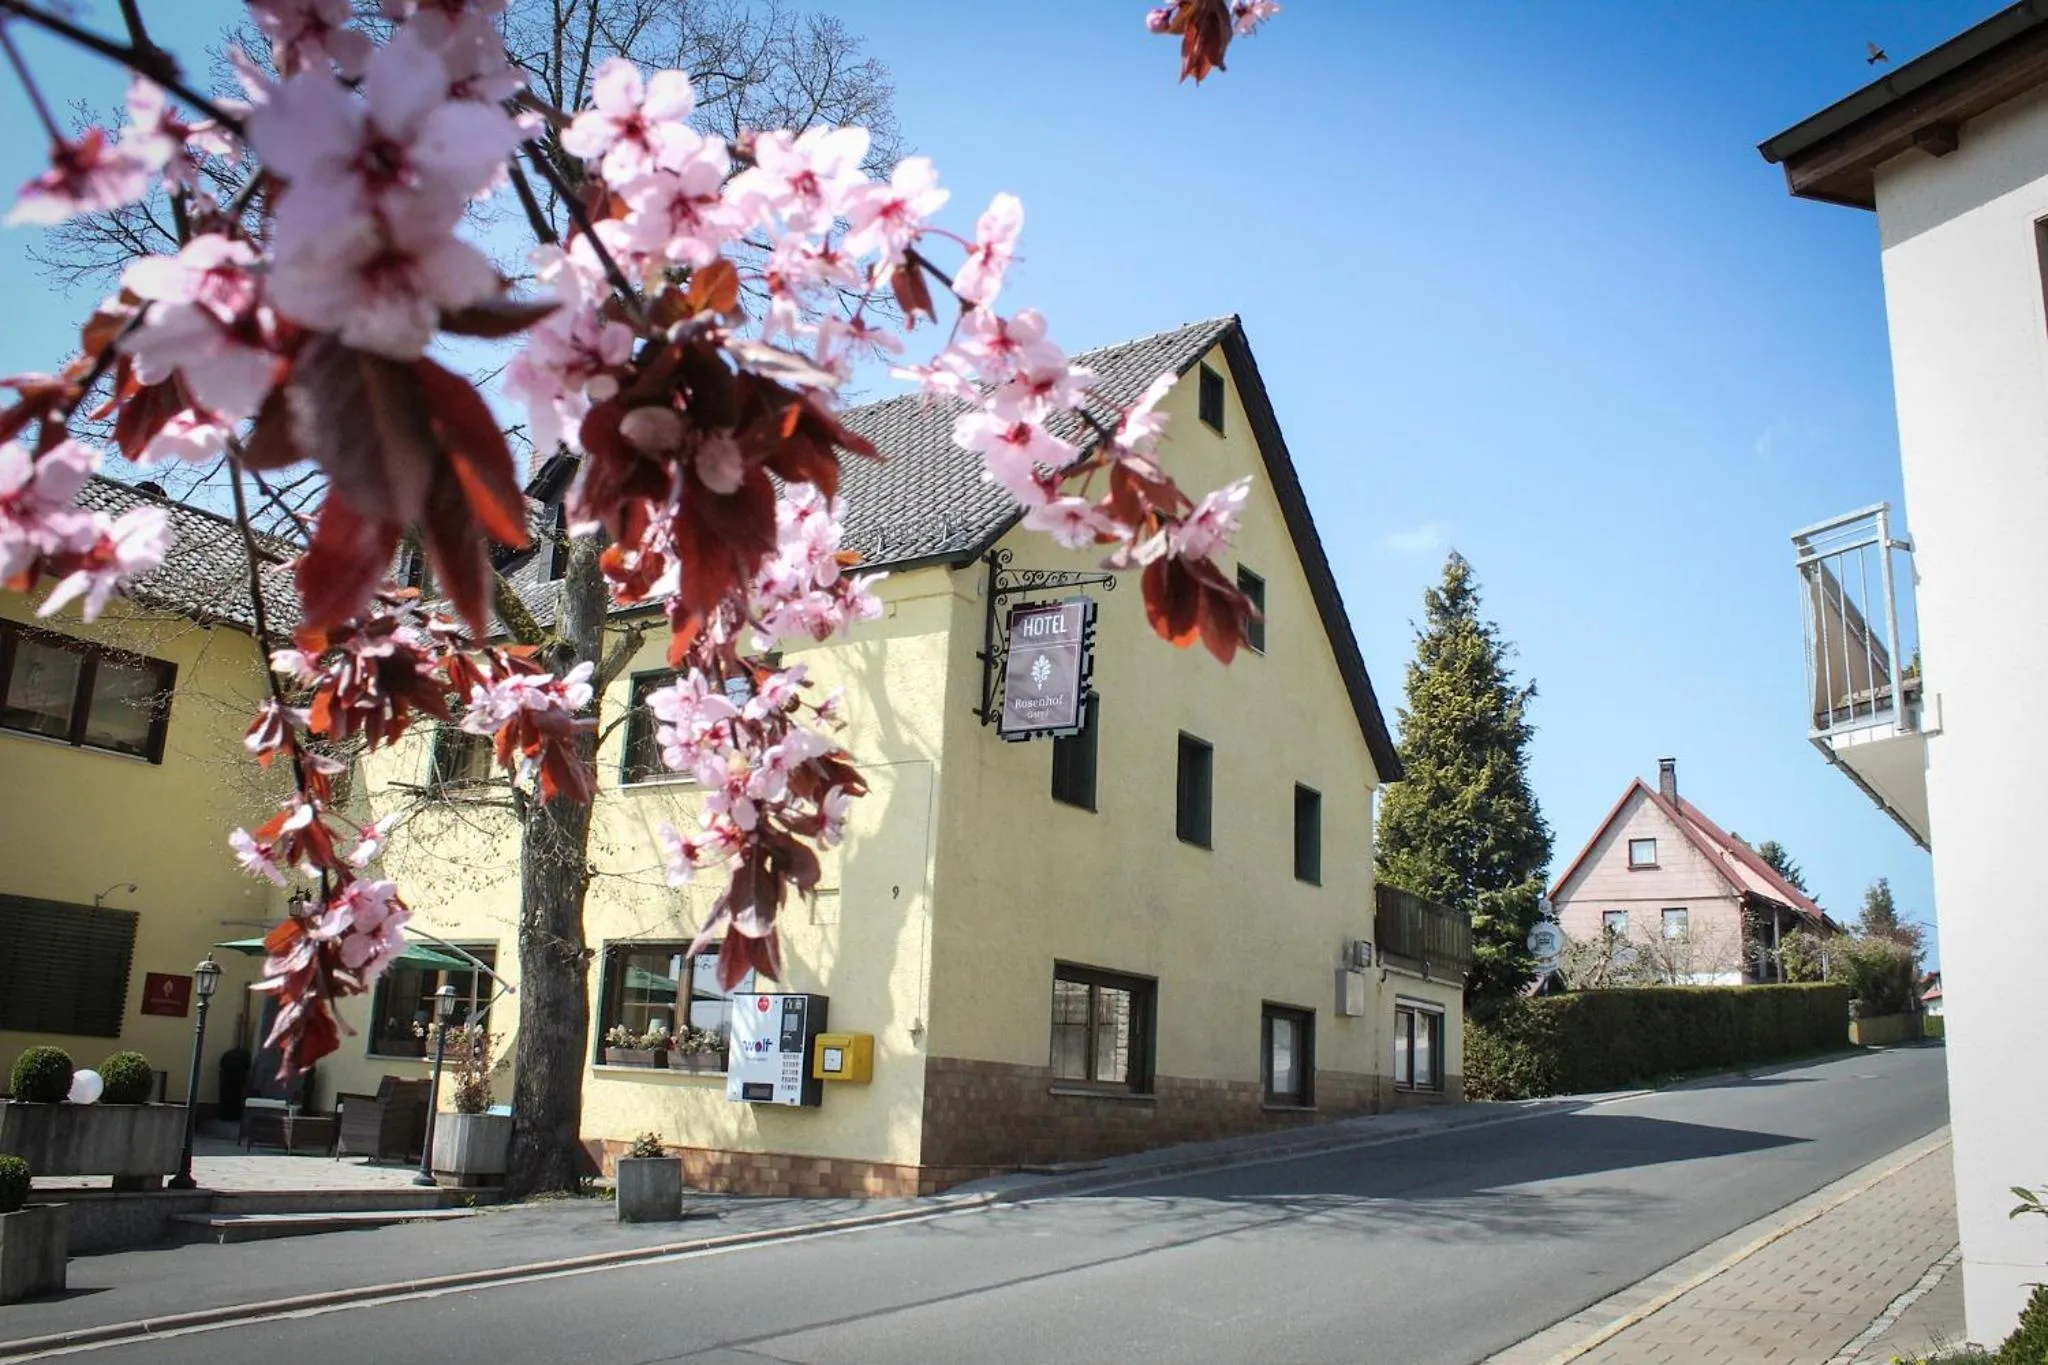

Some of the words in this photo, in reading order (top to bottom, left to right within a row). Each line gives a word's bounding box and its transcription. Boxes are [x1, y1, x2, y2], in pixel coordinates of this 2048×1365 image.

[1023, 614, 1067, 637] HOTEL
[1015, 694, 1064, 709] Rosenhof
[892, 885, 899, 900] 9
